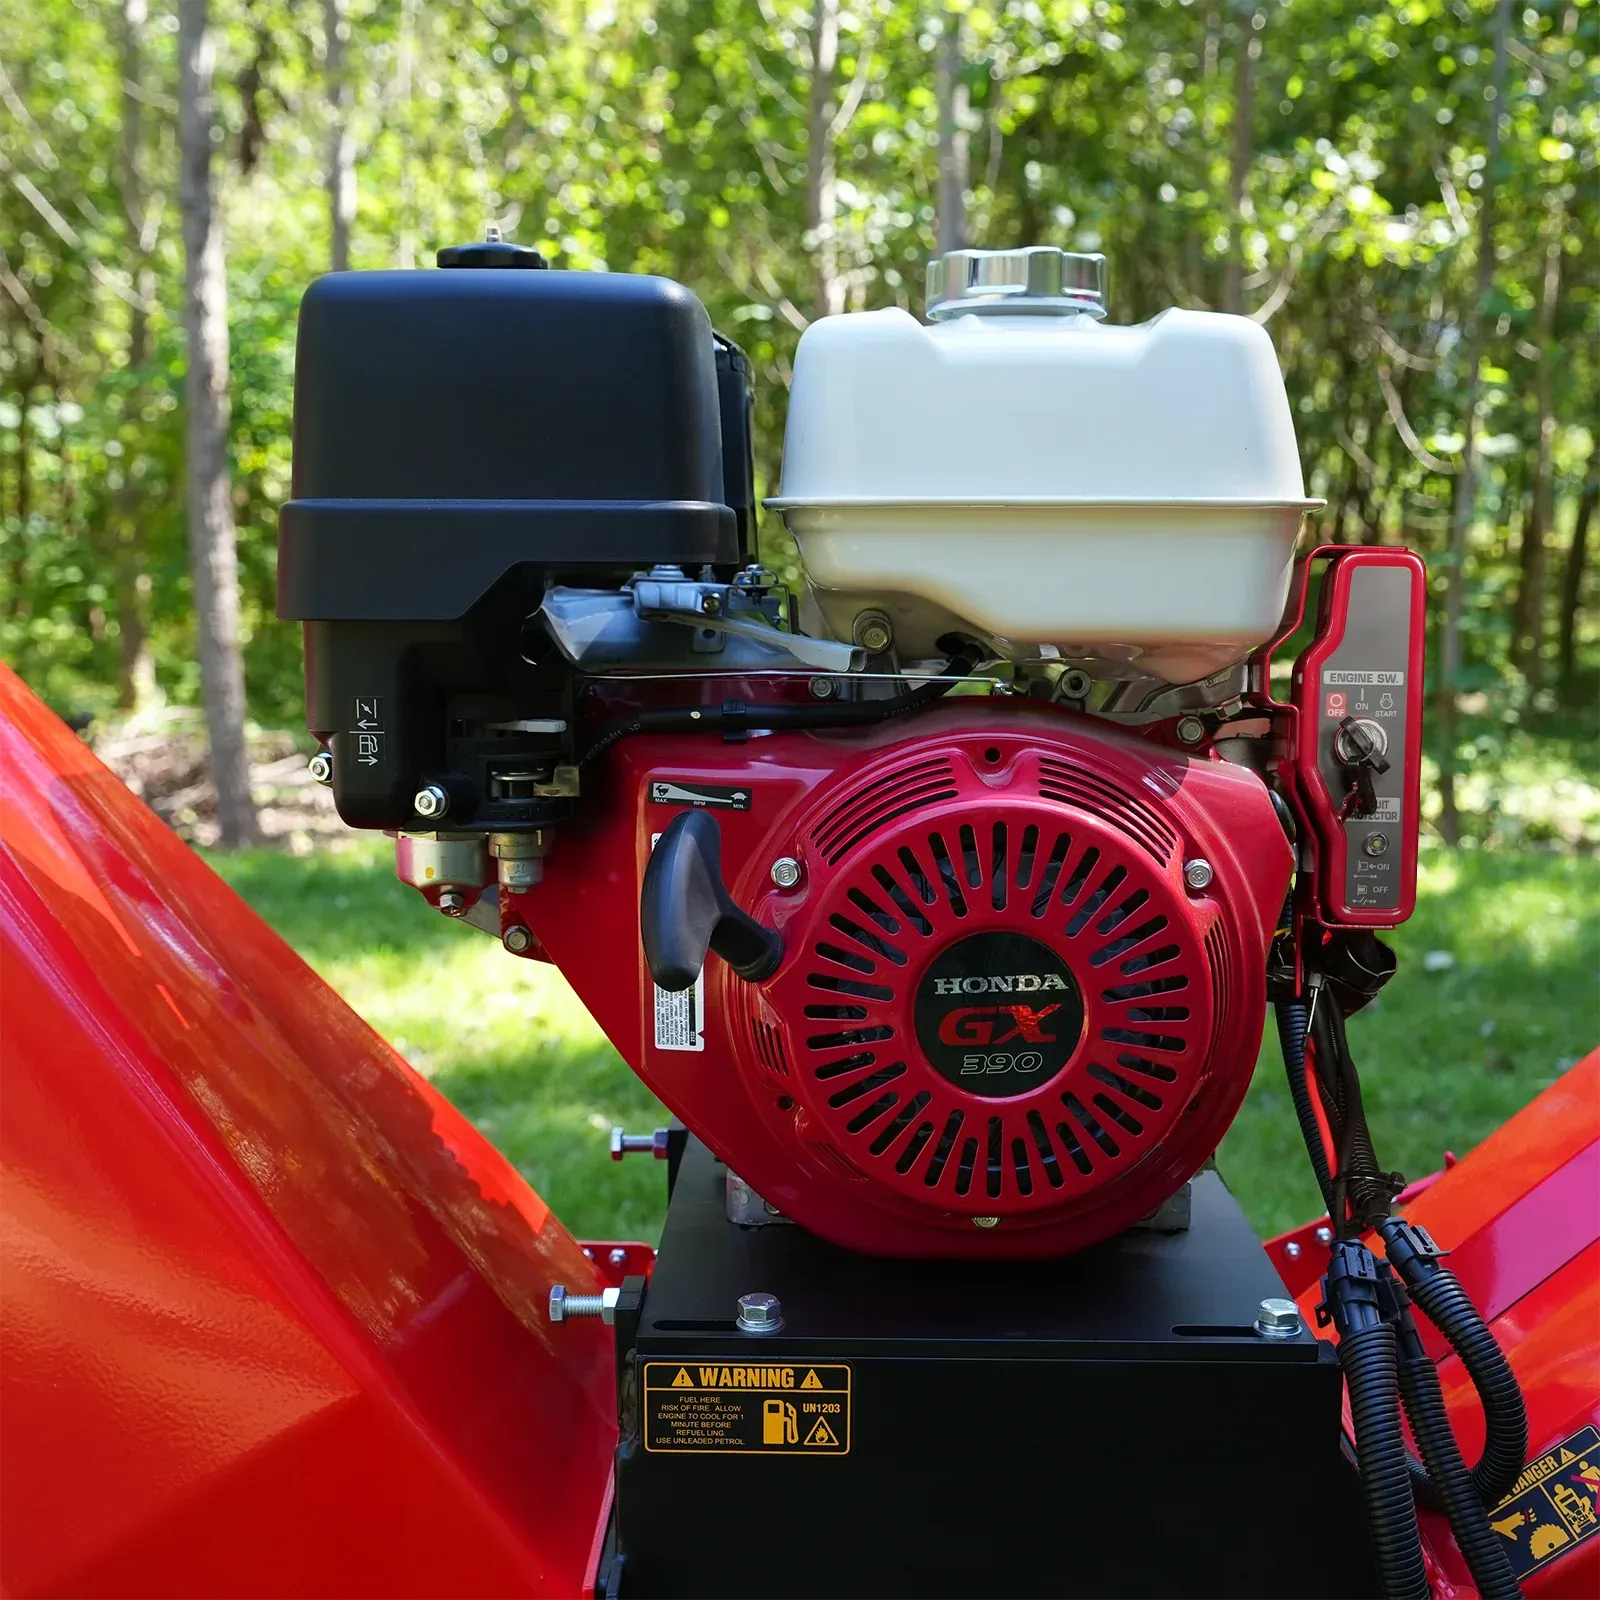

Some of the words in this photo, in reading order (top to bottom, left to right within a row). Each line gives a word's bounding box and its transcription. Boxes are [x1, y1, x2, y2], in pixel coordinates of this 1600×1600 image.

[1330, 673, 1373, 683] ENGINE
[1377, 673, 1399, 684] SW.
[1355, 702, 1369, 710] ON
[1327, 708, 1345, 717] OFF
[1374, 710, 1398, 718] START
[1350, 811, 1398, 821] ROTECTOR
[1376, 863, 1390, 871] ON
[1372, 886, 1389, 894] OFF
[933, 973, 1070, 995] HONDA
[938, 1002, 1064, 1046] GX
[960, 1051, 1043, 1075] 390
[699, 1367, 794, 1388] WARNING
[699, 1396, 723, 1404] HERE.
[661, 1404, 679, 1412] RISK
[802, 1403, 840, 1413] UN1203
[657, 1412, 686, 1420] ENGINE
[701, 1421, 732, 1429] BEFORE
[673, 1437, 713, 1445] UNLEADED
[714, 1438, 747, 1446] PETROL.
